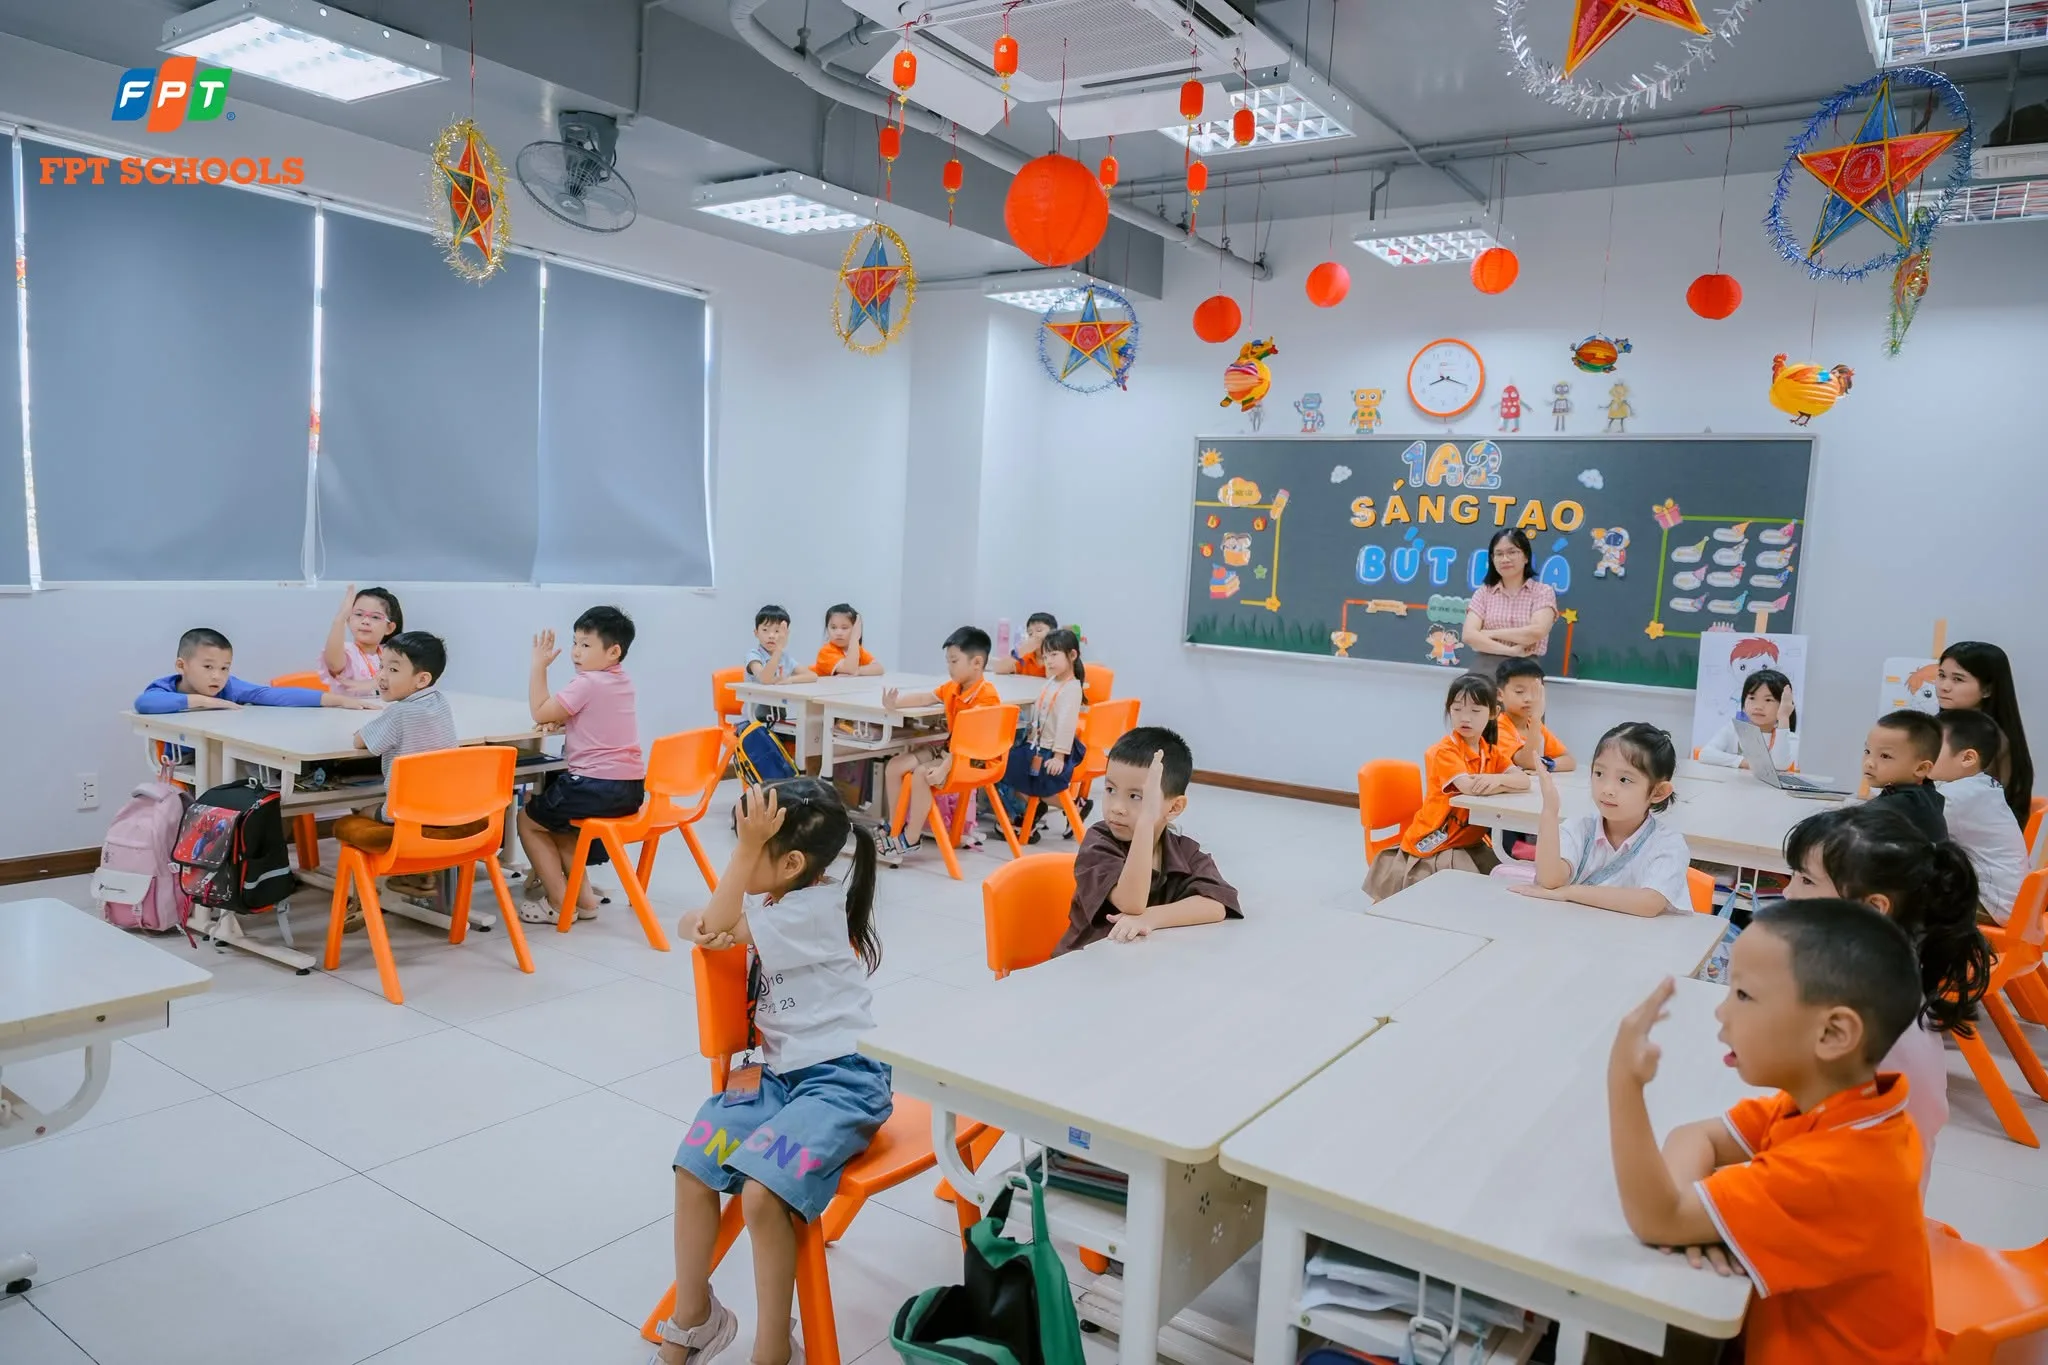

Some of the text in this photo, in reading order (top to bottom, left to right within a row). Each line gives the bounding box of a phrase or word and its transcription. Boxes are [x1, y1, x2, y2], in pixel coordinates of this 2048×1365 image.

[1401, 440, 1503, 490] 1A2
[1350, 478, 1585, 540] SÁNG TẠO
[779, 997, 796, 1011] 23
